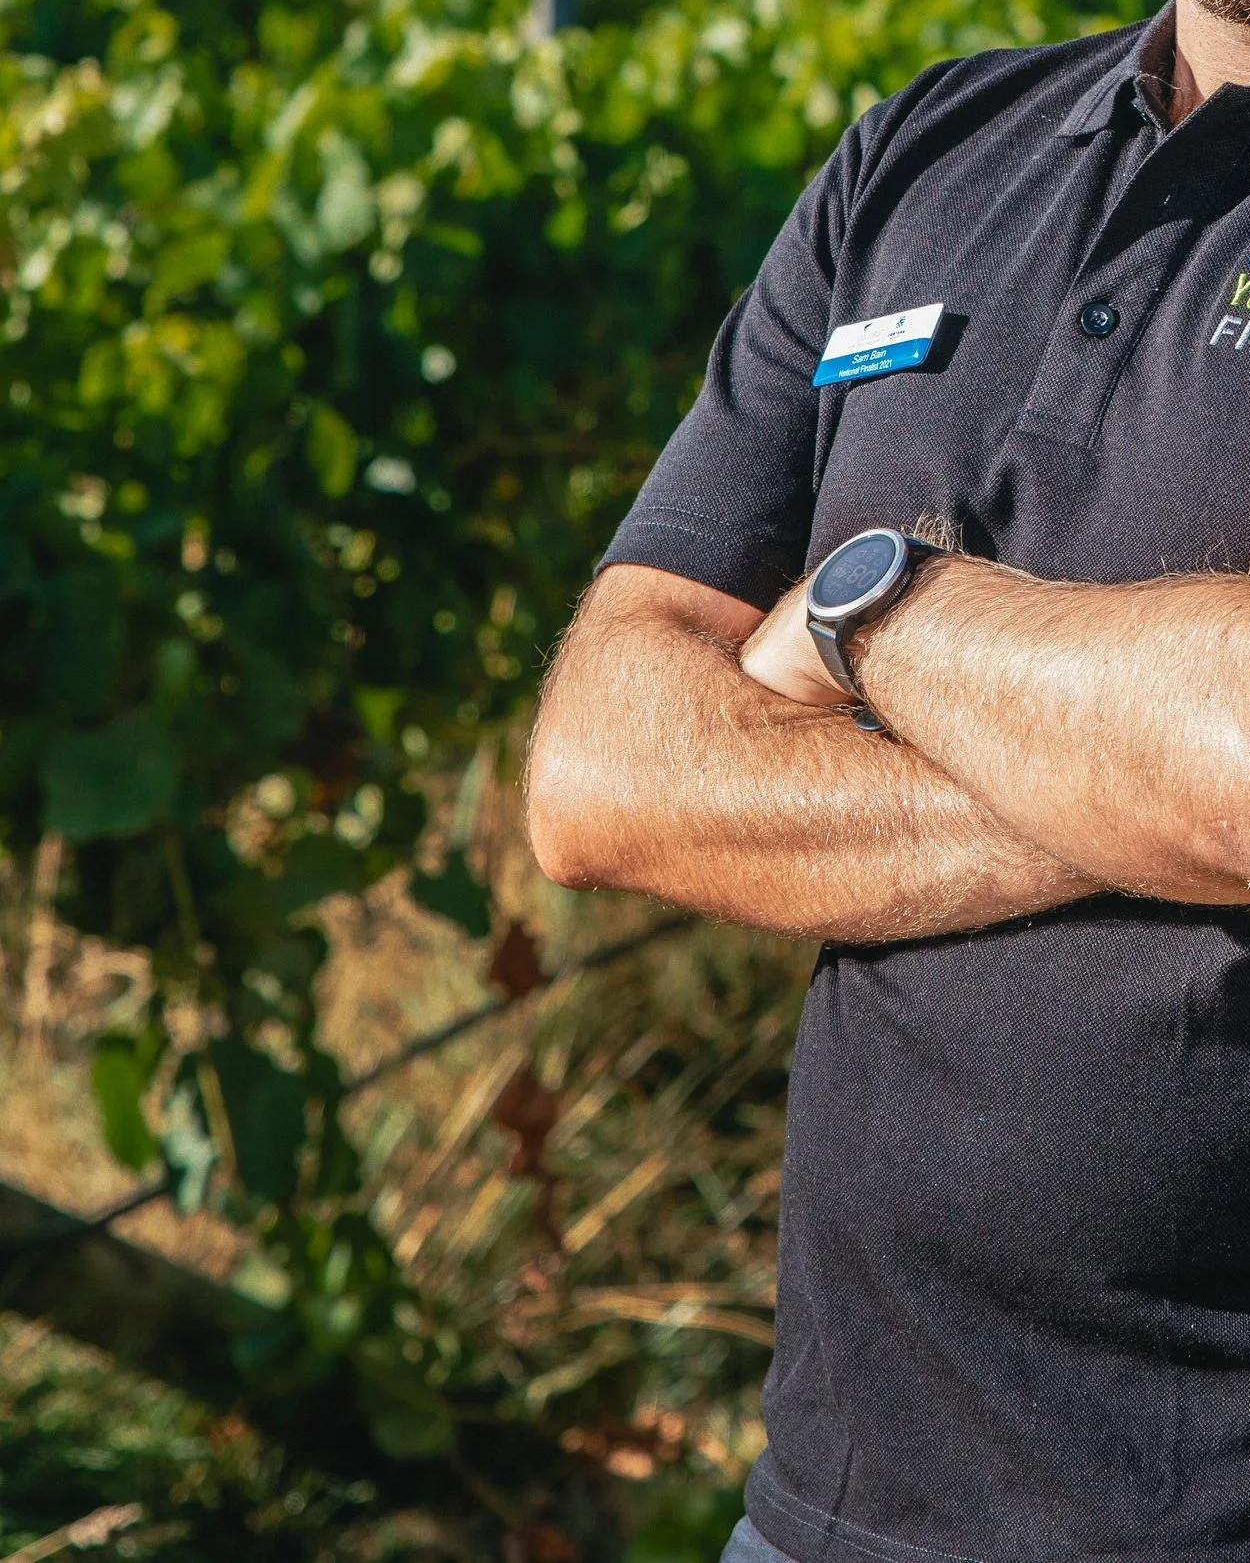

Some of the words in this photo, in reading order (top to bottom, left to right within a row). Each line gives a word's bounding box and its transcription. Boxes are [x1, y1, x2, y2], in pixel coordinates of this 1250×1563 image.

[852, 354, 869, 364] Sam
[870, 349, 887, 360] Bain
[839, 366, 860, 378] National
[860, 363, 879, 373] Finalist
[879, 359, 892, 369] 2021
